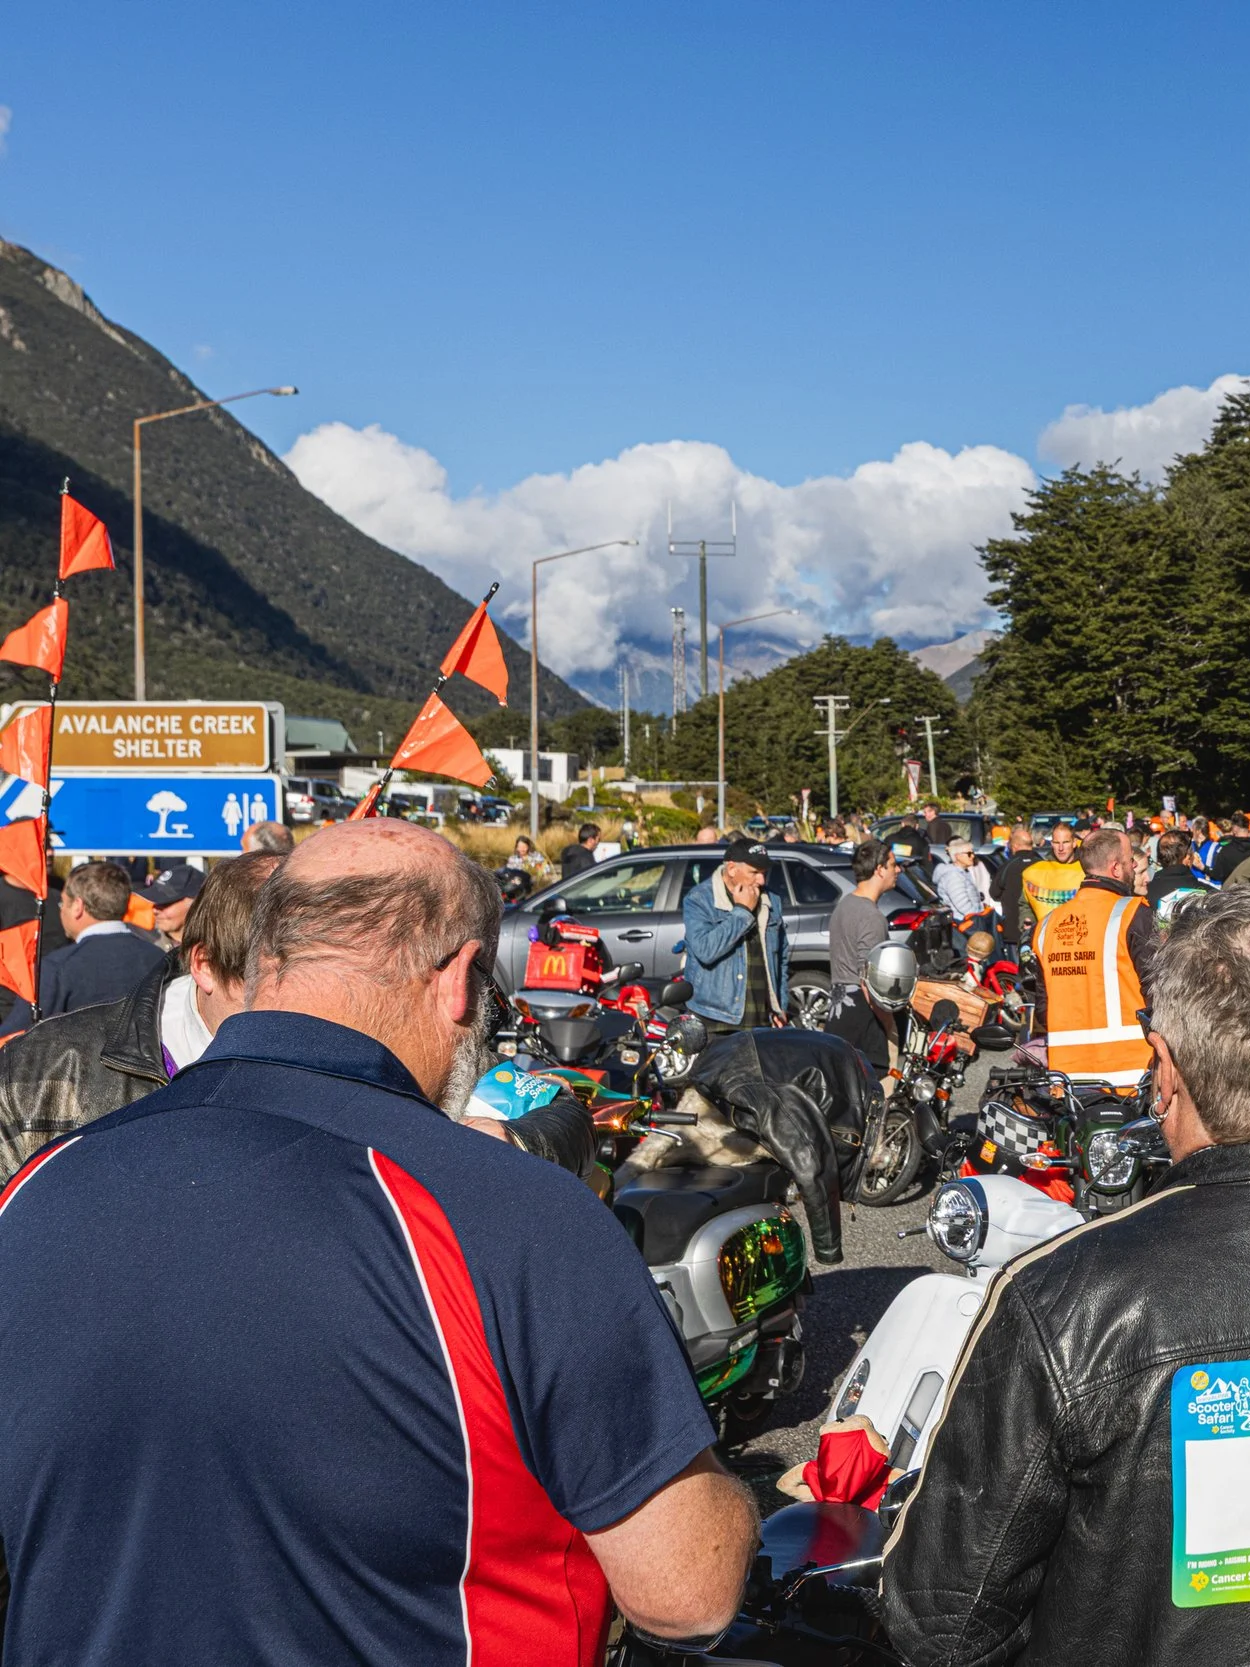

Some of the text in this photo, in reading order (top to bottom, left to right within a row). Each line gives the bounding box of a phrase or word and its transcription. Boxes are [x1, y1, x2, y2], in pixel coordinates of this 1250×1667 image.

[59, 714, 256, 735] AVALANCHE CREEK
[113, 739, 202, 758] SHELTER
[1073, 951, 1096, 961] SAFARI
[1051, 966, 1087, 976] MARSHALL
[1187, 1401, 1236, 1414] Scooter
[1197, 1411, 1234, 1425] Safari
[1211, 1573, 1247, 1585] Cancer
